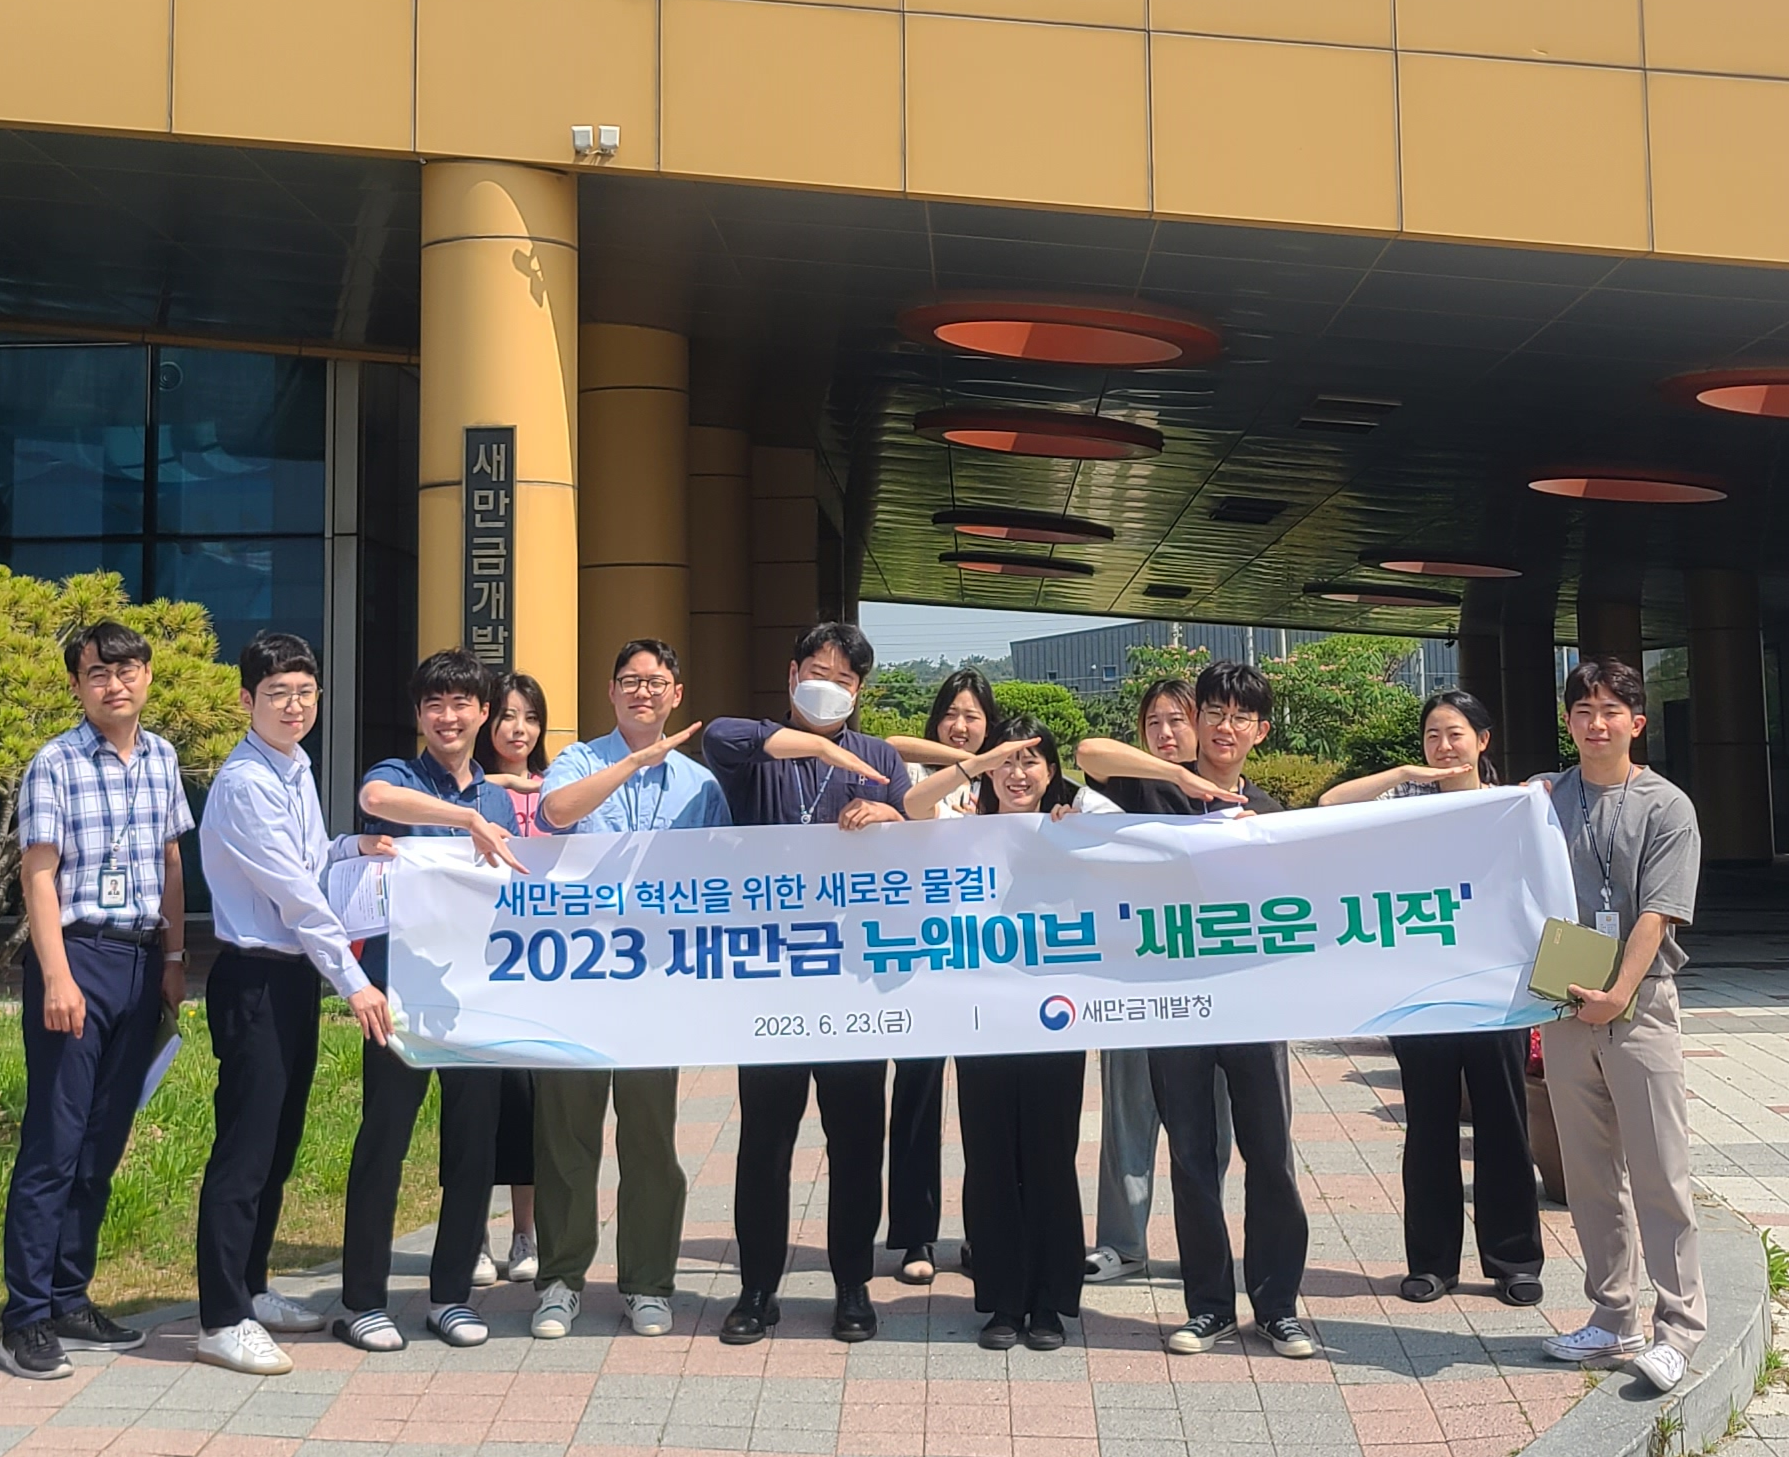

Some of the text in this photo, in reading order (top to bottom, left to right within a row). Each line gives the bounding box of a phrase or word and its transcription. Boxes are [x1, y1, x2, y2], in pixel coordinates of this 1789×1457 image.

[471, 443, 510, 676] 새만금개발
[494, 866, 997, 918] 새만금의 혁신을 위한 새로운 물결!
[487, 928, 648, 983] 2023
[665, 922, 845, 981] 새만금
[862, 912, 1102, 974] 뉴웨이브
[753, 1015, 812, 1038] 2023.
[818, 1014, 838, 1036] 6.
[1081, 994, 1213, 1023] 새만금개발청
